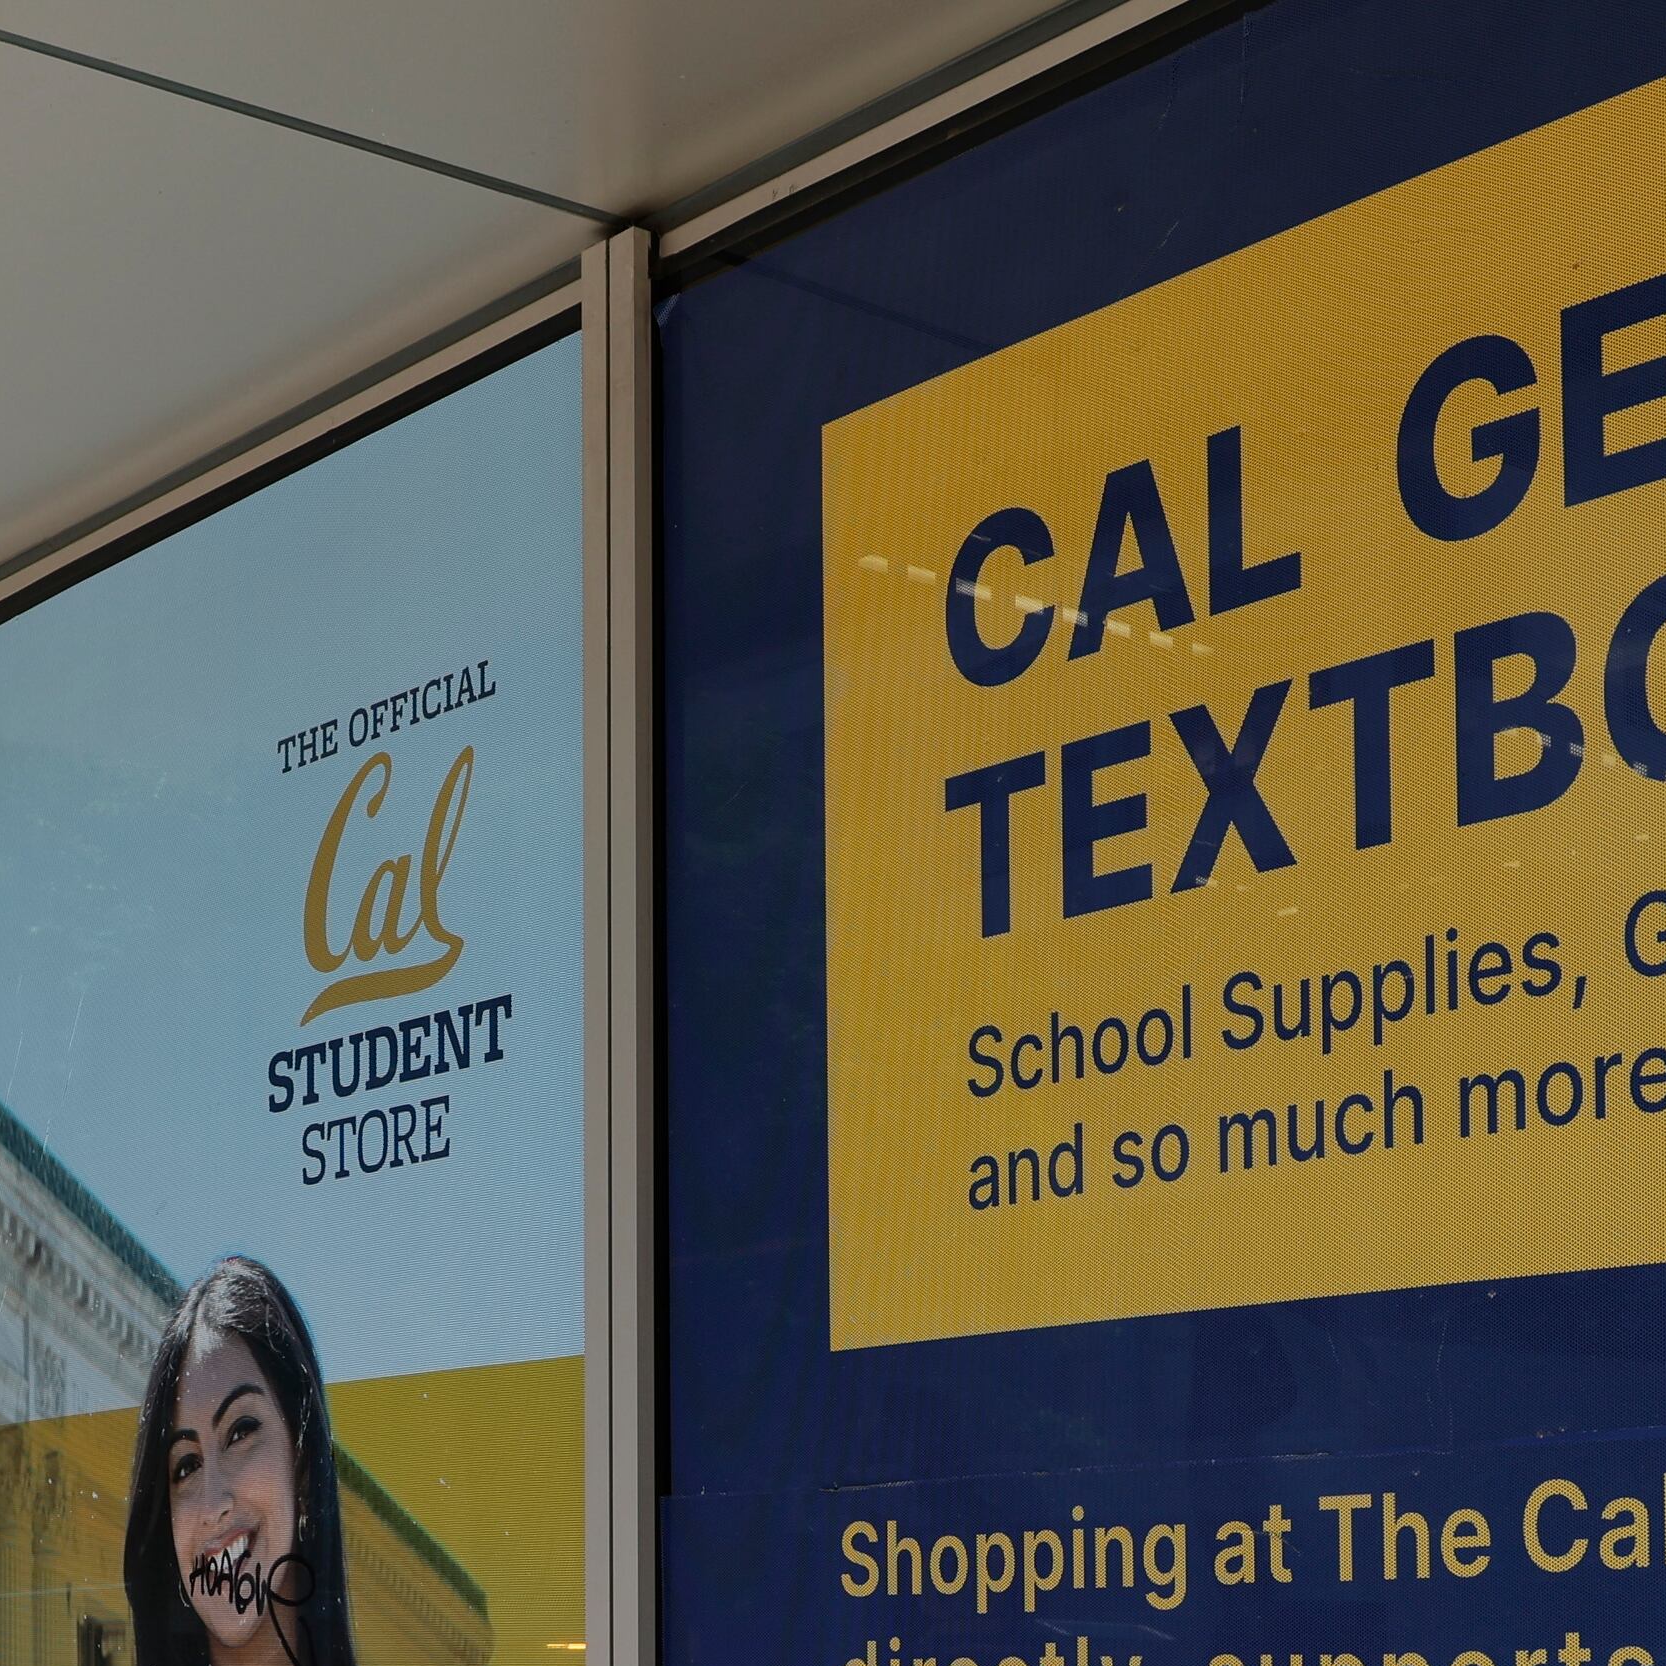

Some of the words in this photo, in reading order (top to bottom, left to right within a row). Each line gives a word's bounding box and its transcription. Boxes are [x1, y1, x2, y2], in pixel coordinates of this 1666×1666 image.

[944, 426, 1303, 688] CAL
[277, 718, 339, 775] THE
[348, 659, 498, 748] OFFICIAL
[300, 745, 475, 1027] Cal
[268, 993, 513, 1114] STUDENT
[966, 986, 1194, 1099] School
[1221, 930, 1589, 1053] Supplies,
[301, 1094, 452, 1186] STORE
[966, 1124, 1086, 1211] and
[1111, 1122, 1192, 1190] so
[1217, 1070, 1426, 1172] much
[840, 1505, 1188, 1611] Shopping
[1214, 1504, 1292, 1585] at
[1318, 1494, 1492, 1581] The
